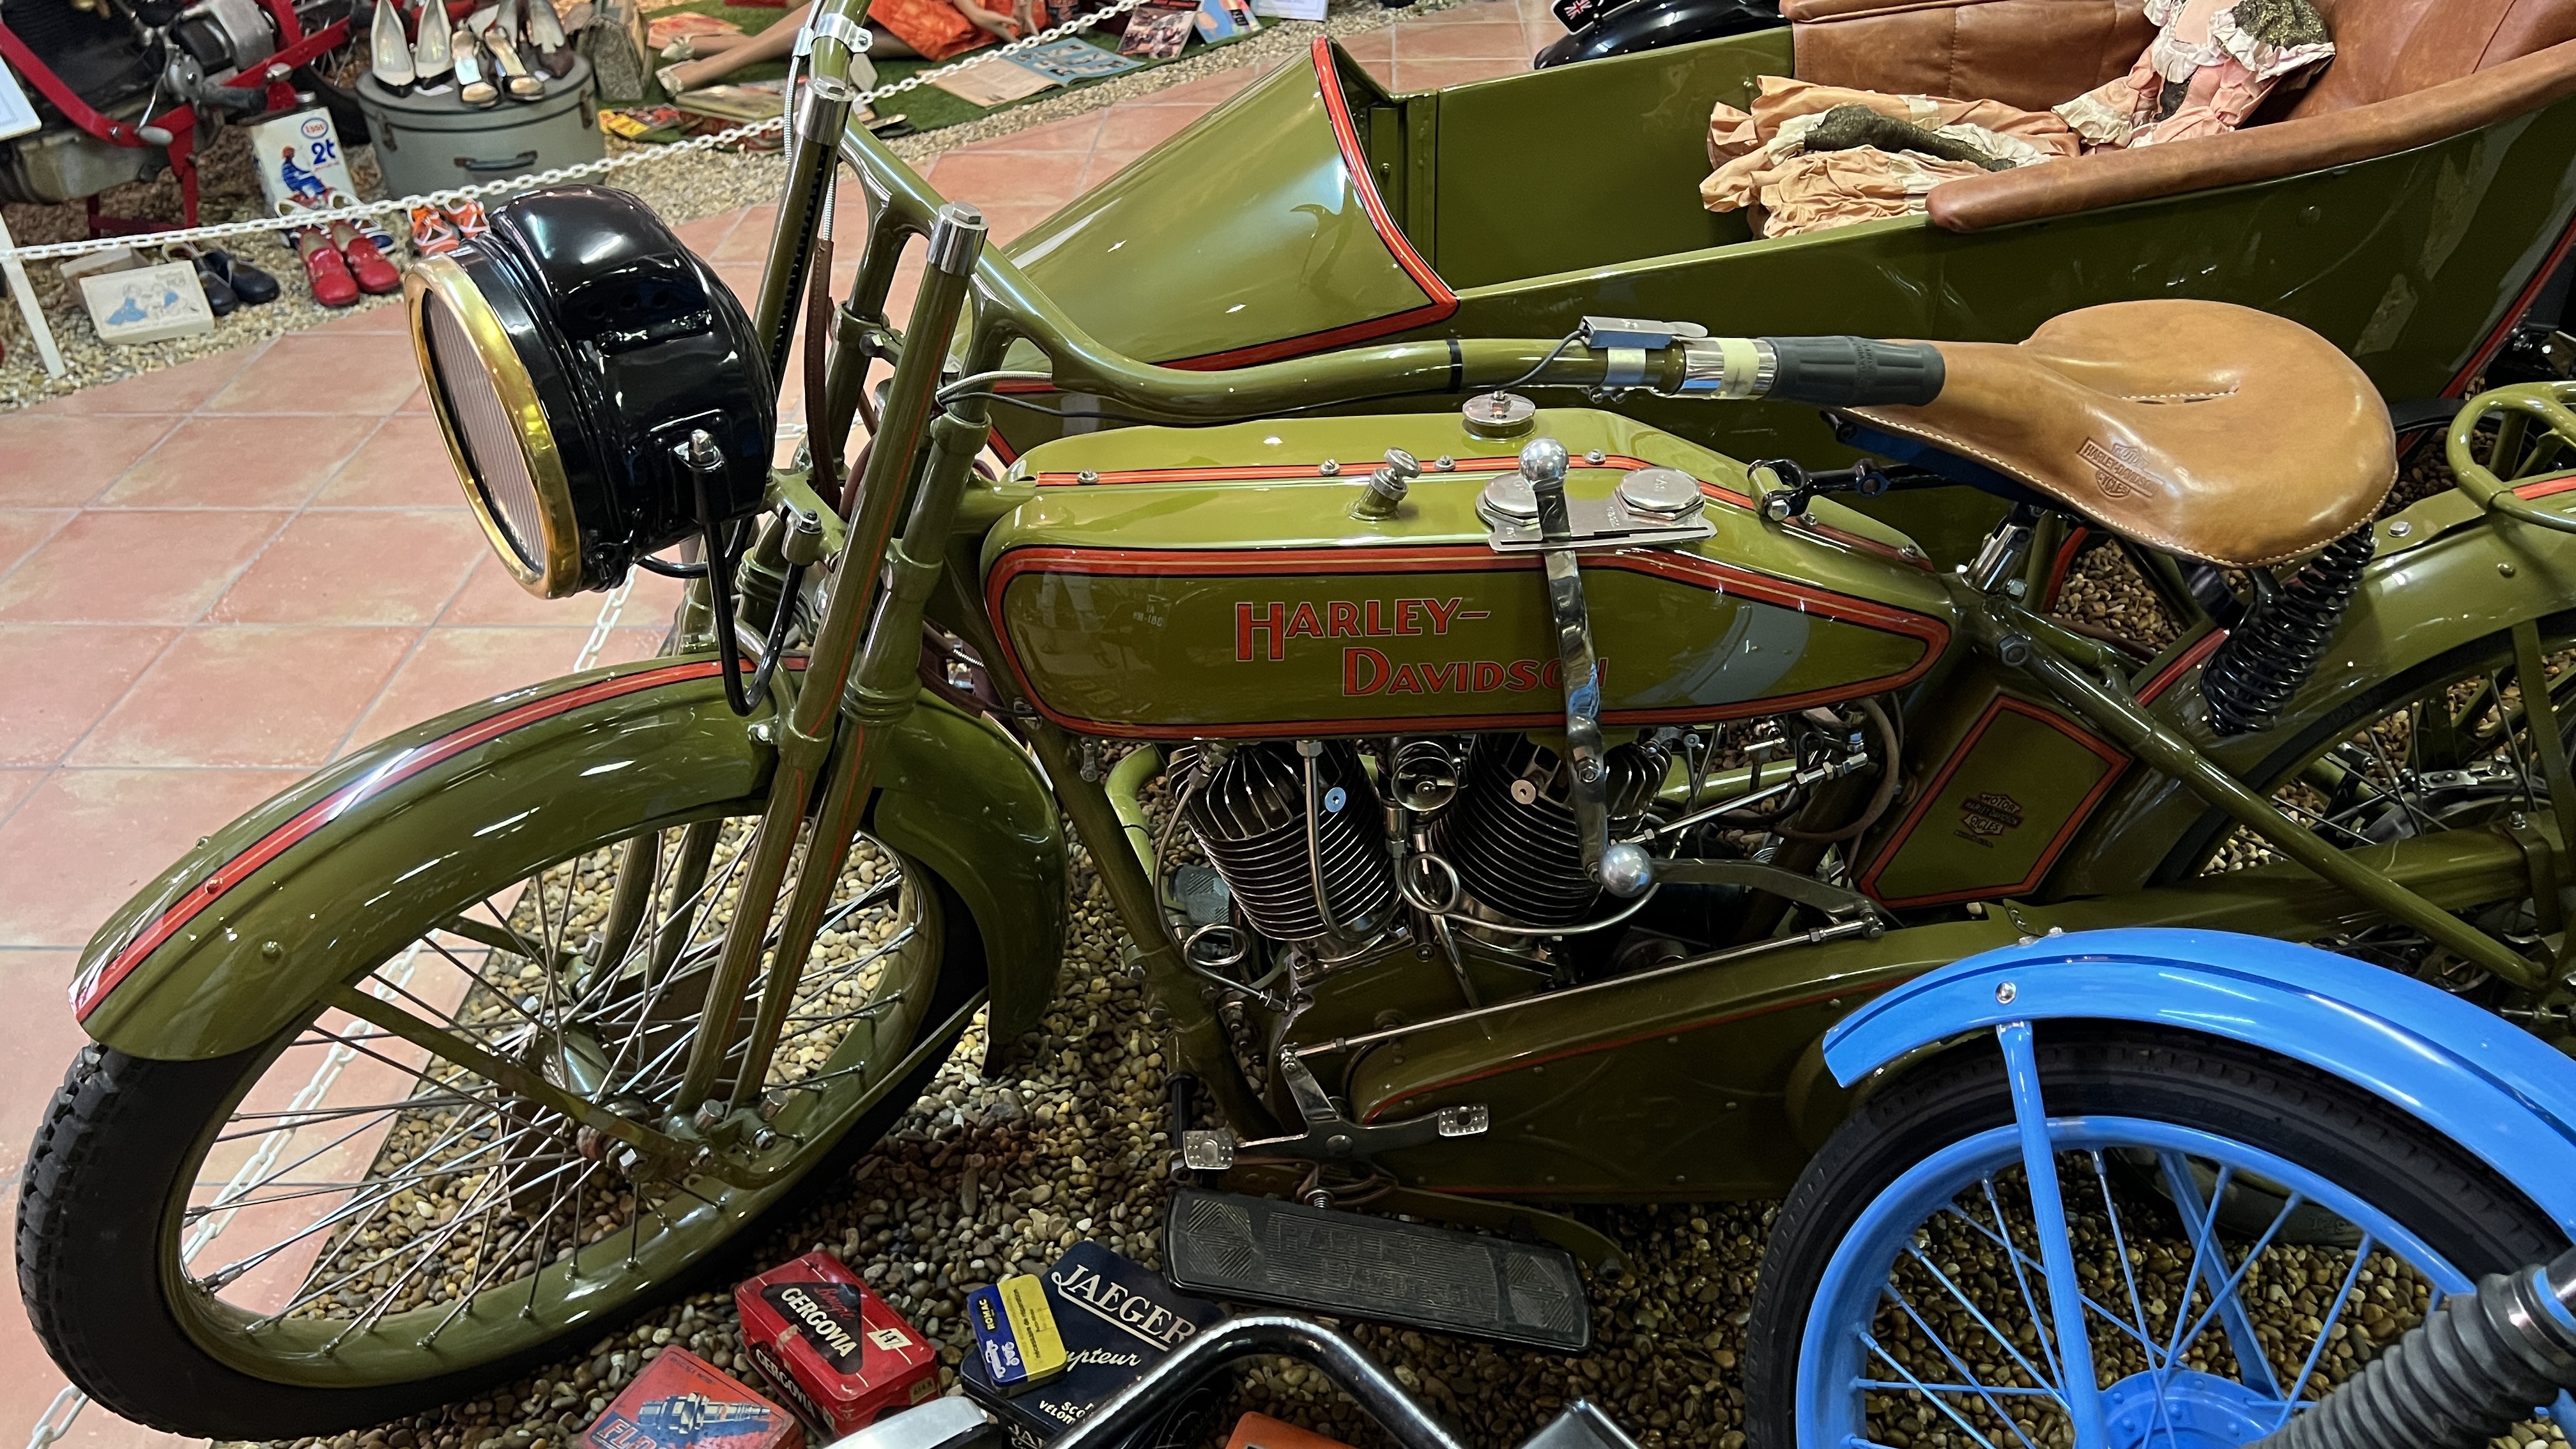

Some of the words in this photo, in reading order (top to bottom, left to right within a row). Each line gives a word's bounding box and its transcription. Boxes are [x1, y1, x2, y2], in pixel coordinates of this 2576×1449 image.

[2097, 471, 2129, 494] CYCLES
[1342, 647, 1608, 696] DAVIDSO
[1982, 795, 2016, 812] MOTOR
[1970, 815, 2000, 831] CYCLES
[979, 1299, 996, 1331] ROMAC
[1051, 1264, 1196, 1344] JAEGER
[1039, 1400, 1077, 1425] VÉLOM
[1061, 1401, 1085, 1419] SCO
